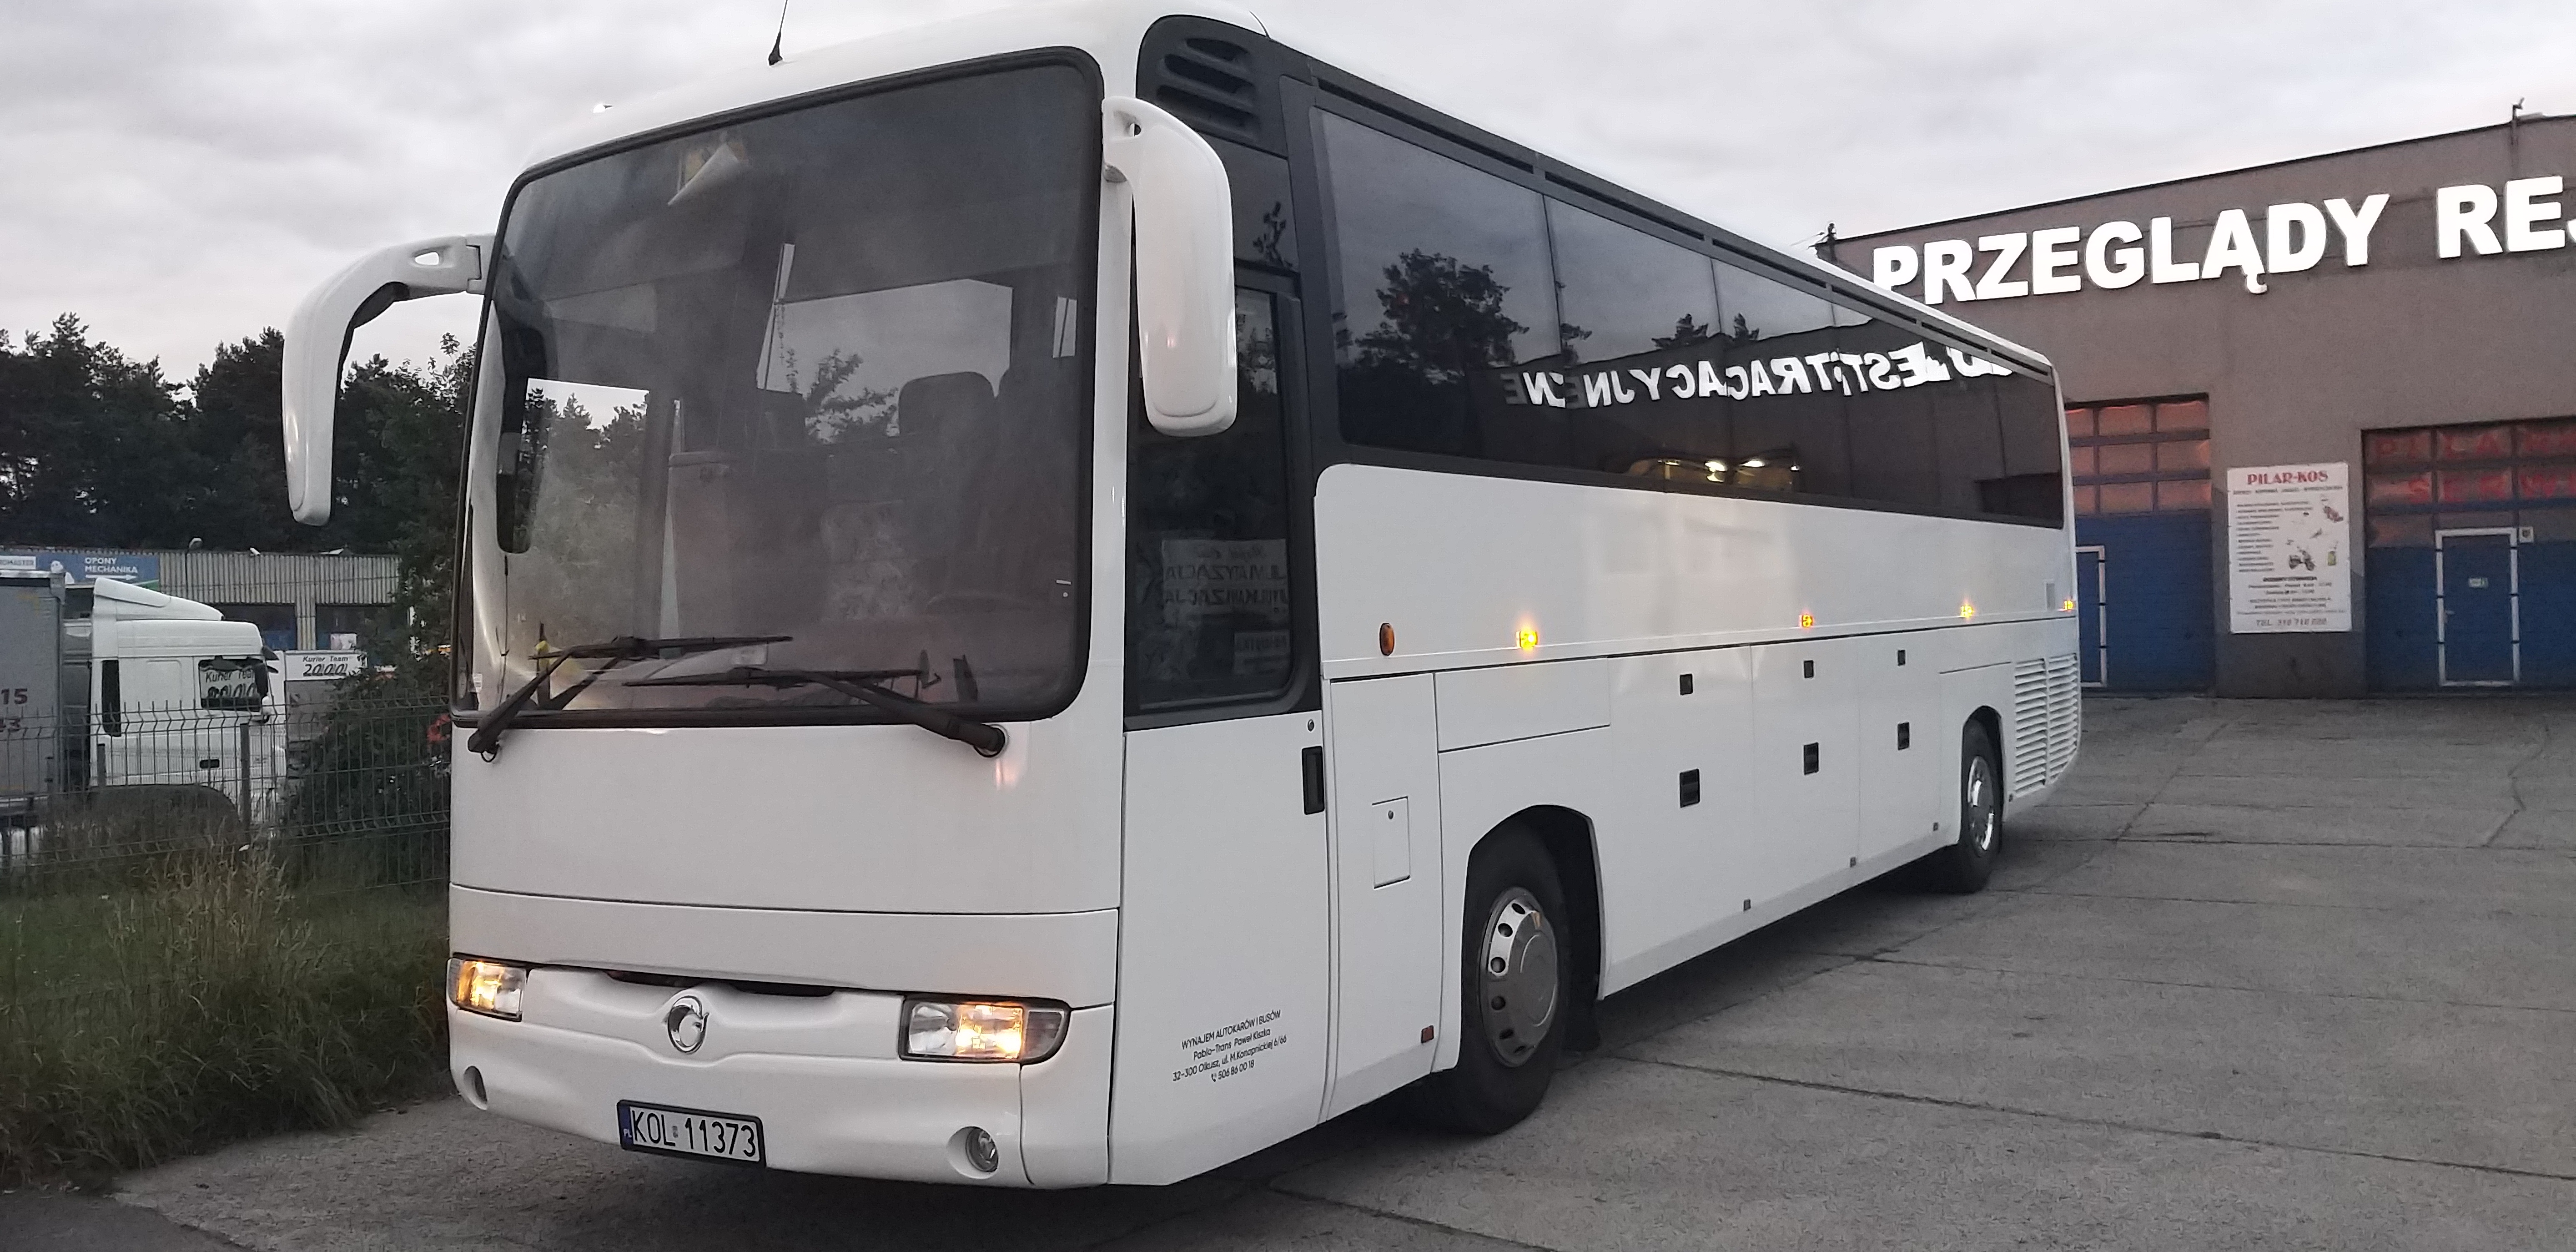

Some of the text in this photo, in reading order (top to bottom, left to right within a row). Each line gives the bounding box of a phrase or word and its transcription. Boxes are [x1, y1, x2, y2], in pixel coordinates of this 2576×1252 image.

[1873, 176, 2576, 305] PRZEGLĄDY RE
[2247, 470, 2328, 485] PILAR-KOS
[1, 688, 28, 705] 15
[1182, 1032, 1214, 1050] WYNAJEM
[1216, 1018, 1255, 1039] AUTOKARÓW
[1259, 1009, 1281, 1024] BUSÓW
[1172, 1065, 1197, 1082] 32-300
[1218, 1069, 1230, 1080] 506
[1239, 1062, 1248, 1073] 00
[623, 1128, 632, 1138] PL
[632, 1110, 756, 1157] KOL 11373
